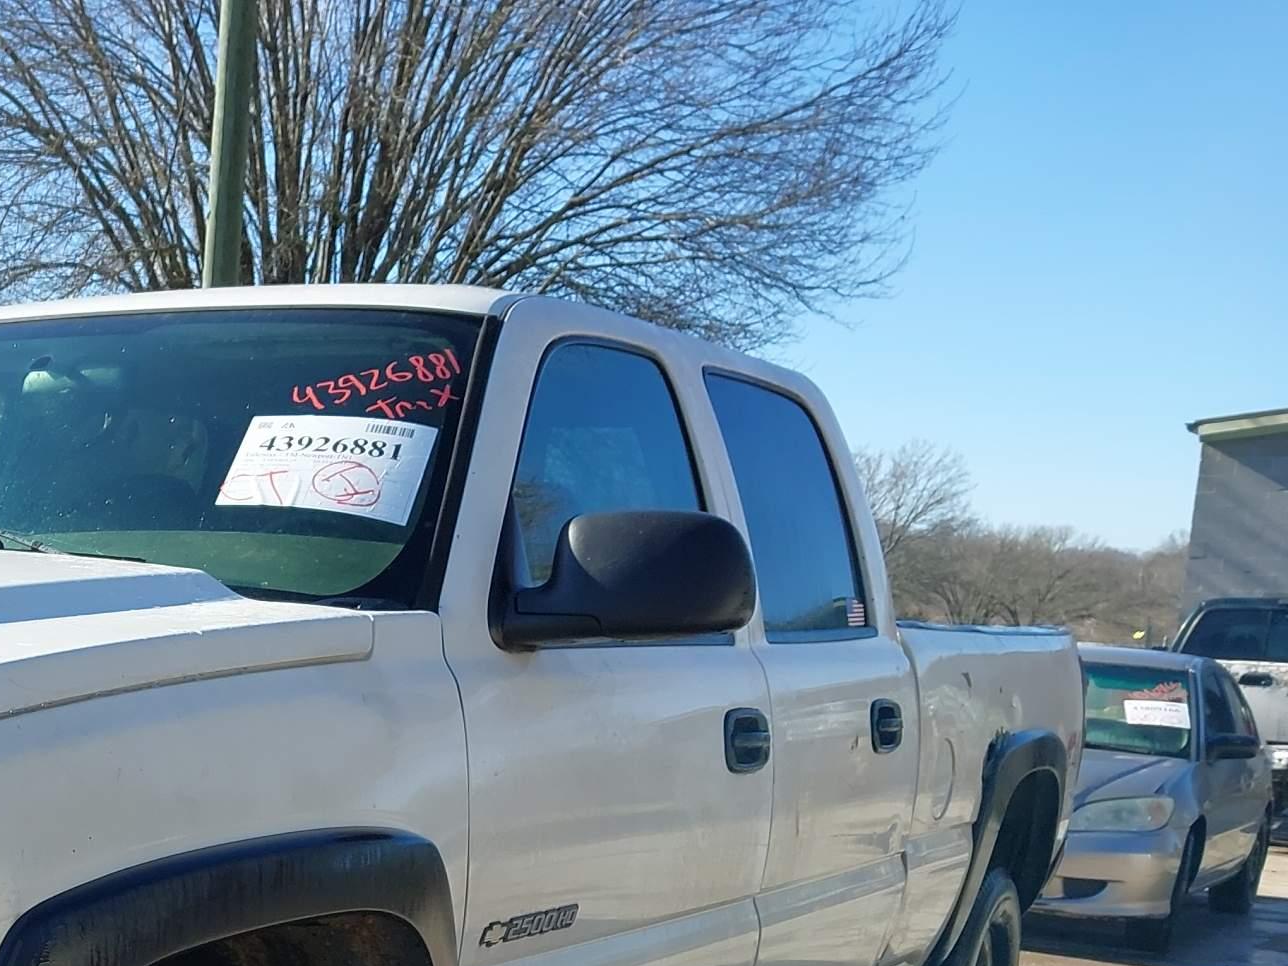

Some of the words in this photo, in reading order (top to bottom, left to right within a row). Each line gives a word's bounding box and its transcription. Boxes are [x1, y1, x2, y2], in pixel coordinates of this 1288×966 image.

[292, 349, 460, 409] 43926881
[259, 434, 402, 461] 43926881
[506, 907, 578, 940] 2500HD
